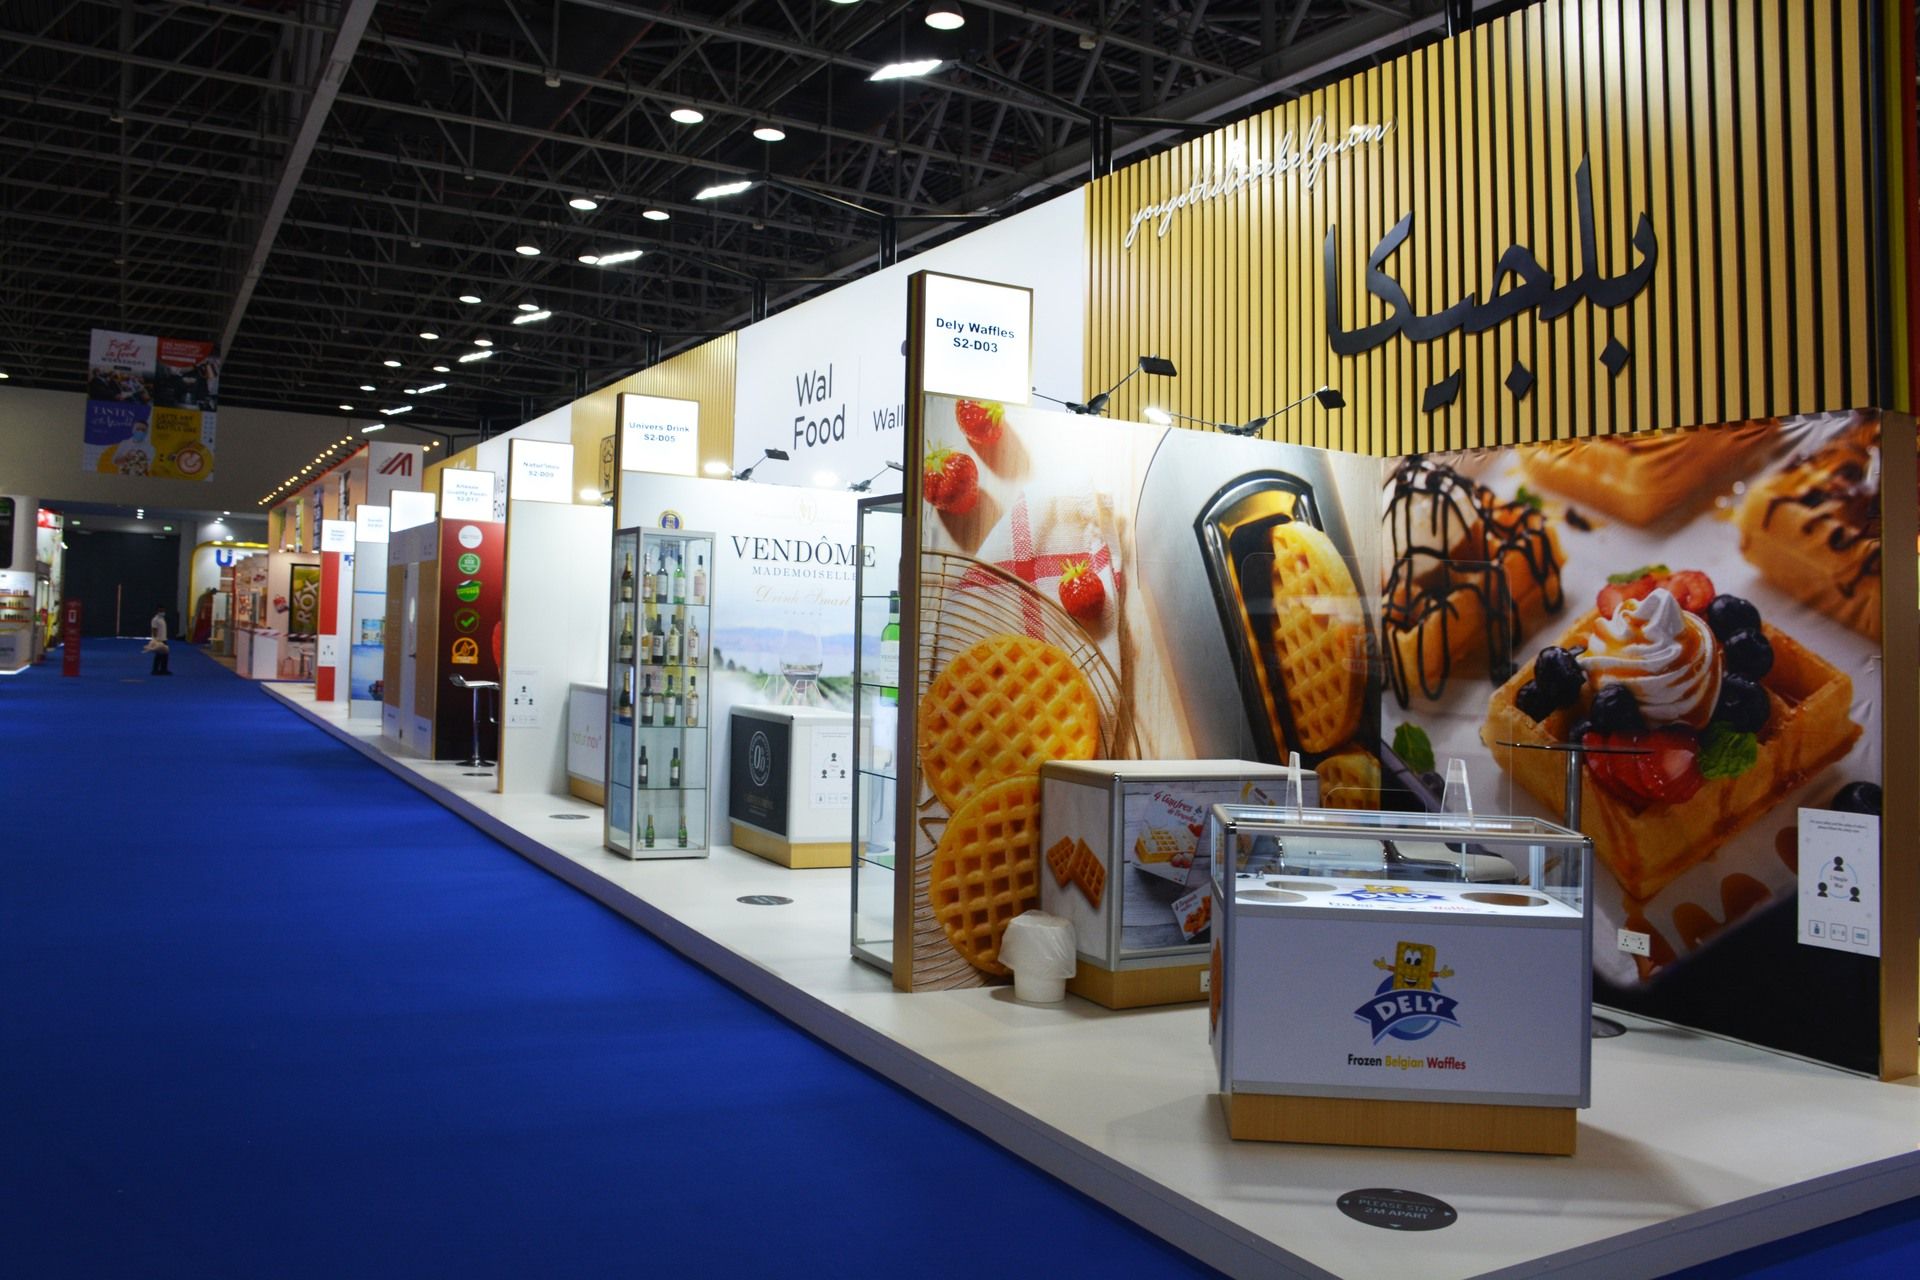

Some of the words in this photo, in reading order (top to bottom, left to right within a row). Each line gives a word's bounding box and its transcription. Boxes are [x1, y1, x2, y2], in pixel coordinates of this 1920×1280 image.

[1324, 152, 1657, 413] بلجيكا
[936, 317, 965, 334] Dely
[968, 322, 1015, 339] Waffles
[953, 337, 998, 353] S2-D03
[796, 363, 833, 407] Wal
[629, 421, 664, 431] Univers
[666, 424, 690, 433] Drink
[794, 403, 846, 450] Food
[643, 433, 676, 443] S2-D05
[731, 535, 877, 568] VENDÔME
[1373, 995, 1443, 1021] DELY
[1347, 1053, 1383, 1067] Frozen
[1384, 1055, 1424, 1070] Belgian
[1426, 1056, 1467, 1070] Waffles
[1357, 1199, 1403, 1210] PLEASE
[1406, 1203, 1437, 1214] STAY
[1388, 1209, 1428, 1220] APART
